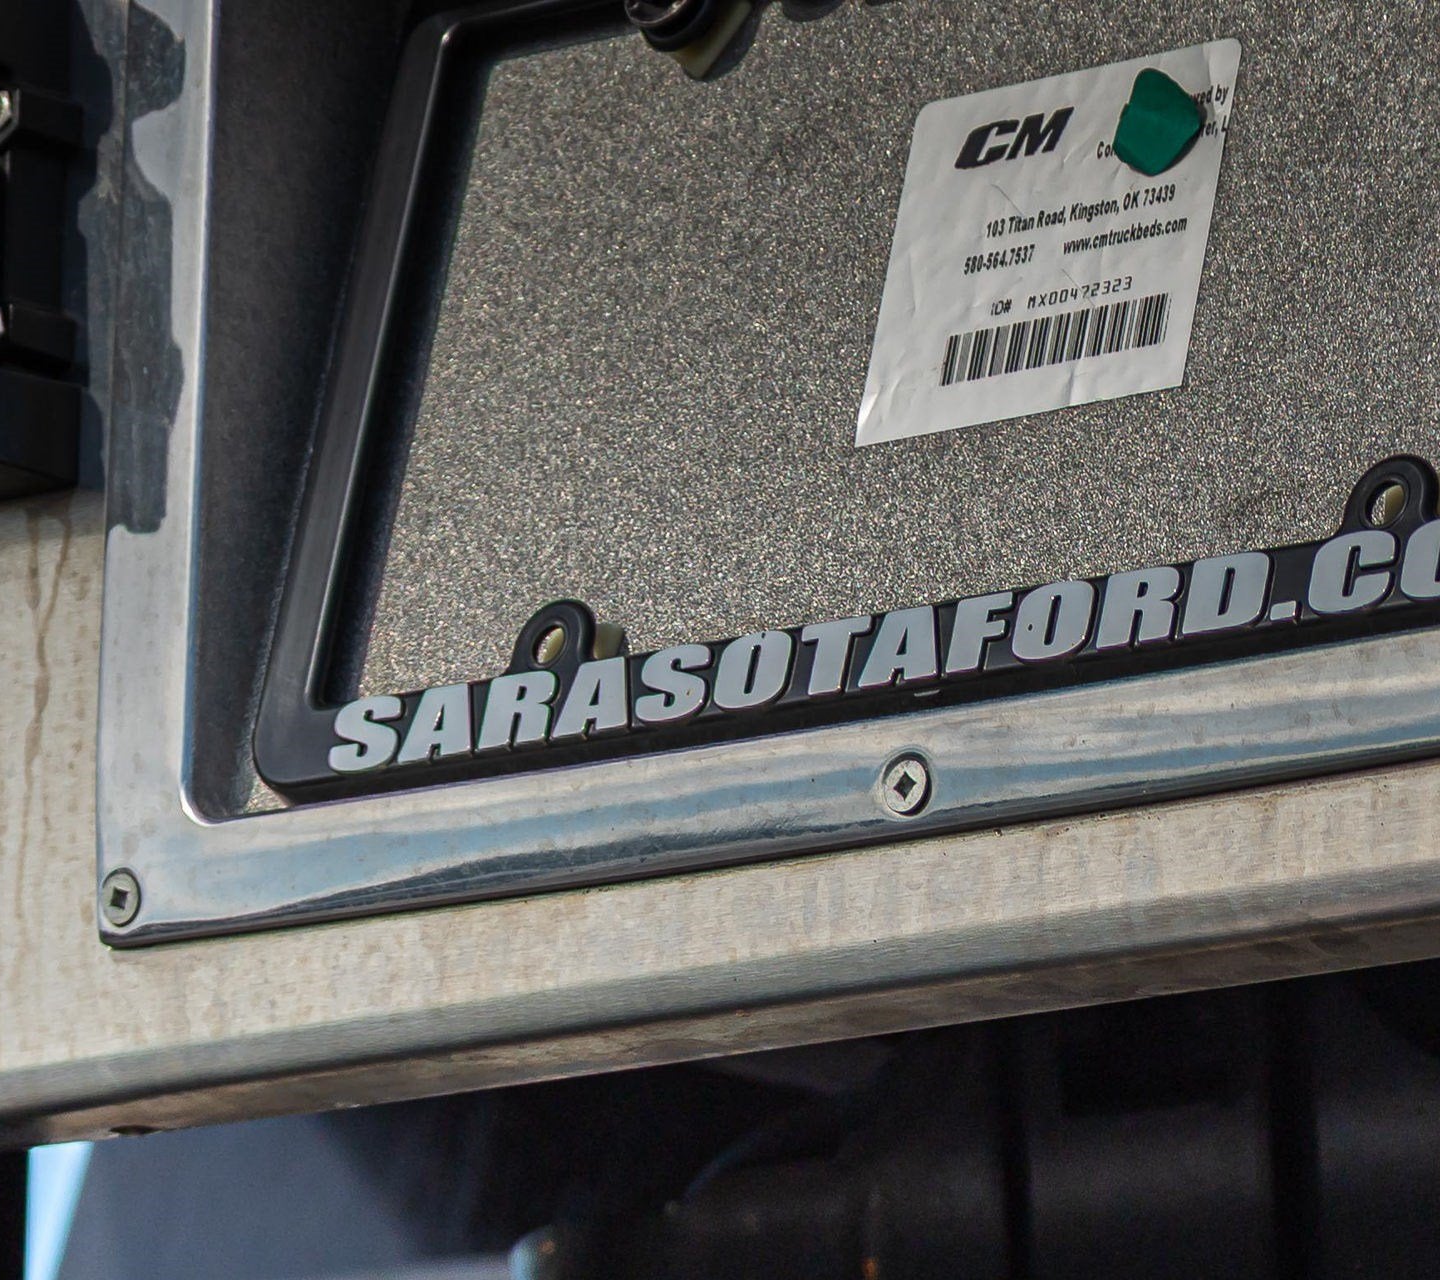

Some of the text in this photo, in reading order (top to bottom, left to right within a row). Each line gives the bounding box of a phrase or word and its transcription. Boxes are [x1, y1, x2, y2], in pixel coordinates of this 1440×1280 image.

[1215, 84, 1229, 105] by
[954, 107, 1075, 170] CM
[986, 183, 1177, 239] 103 Titan Road, Kingston, OK 73439
[963, 215, 1188, 276] 580-564.7537 www.cmtruckbeds.com
[990, 299, 1013, 317] ID#
